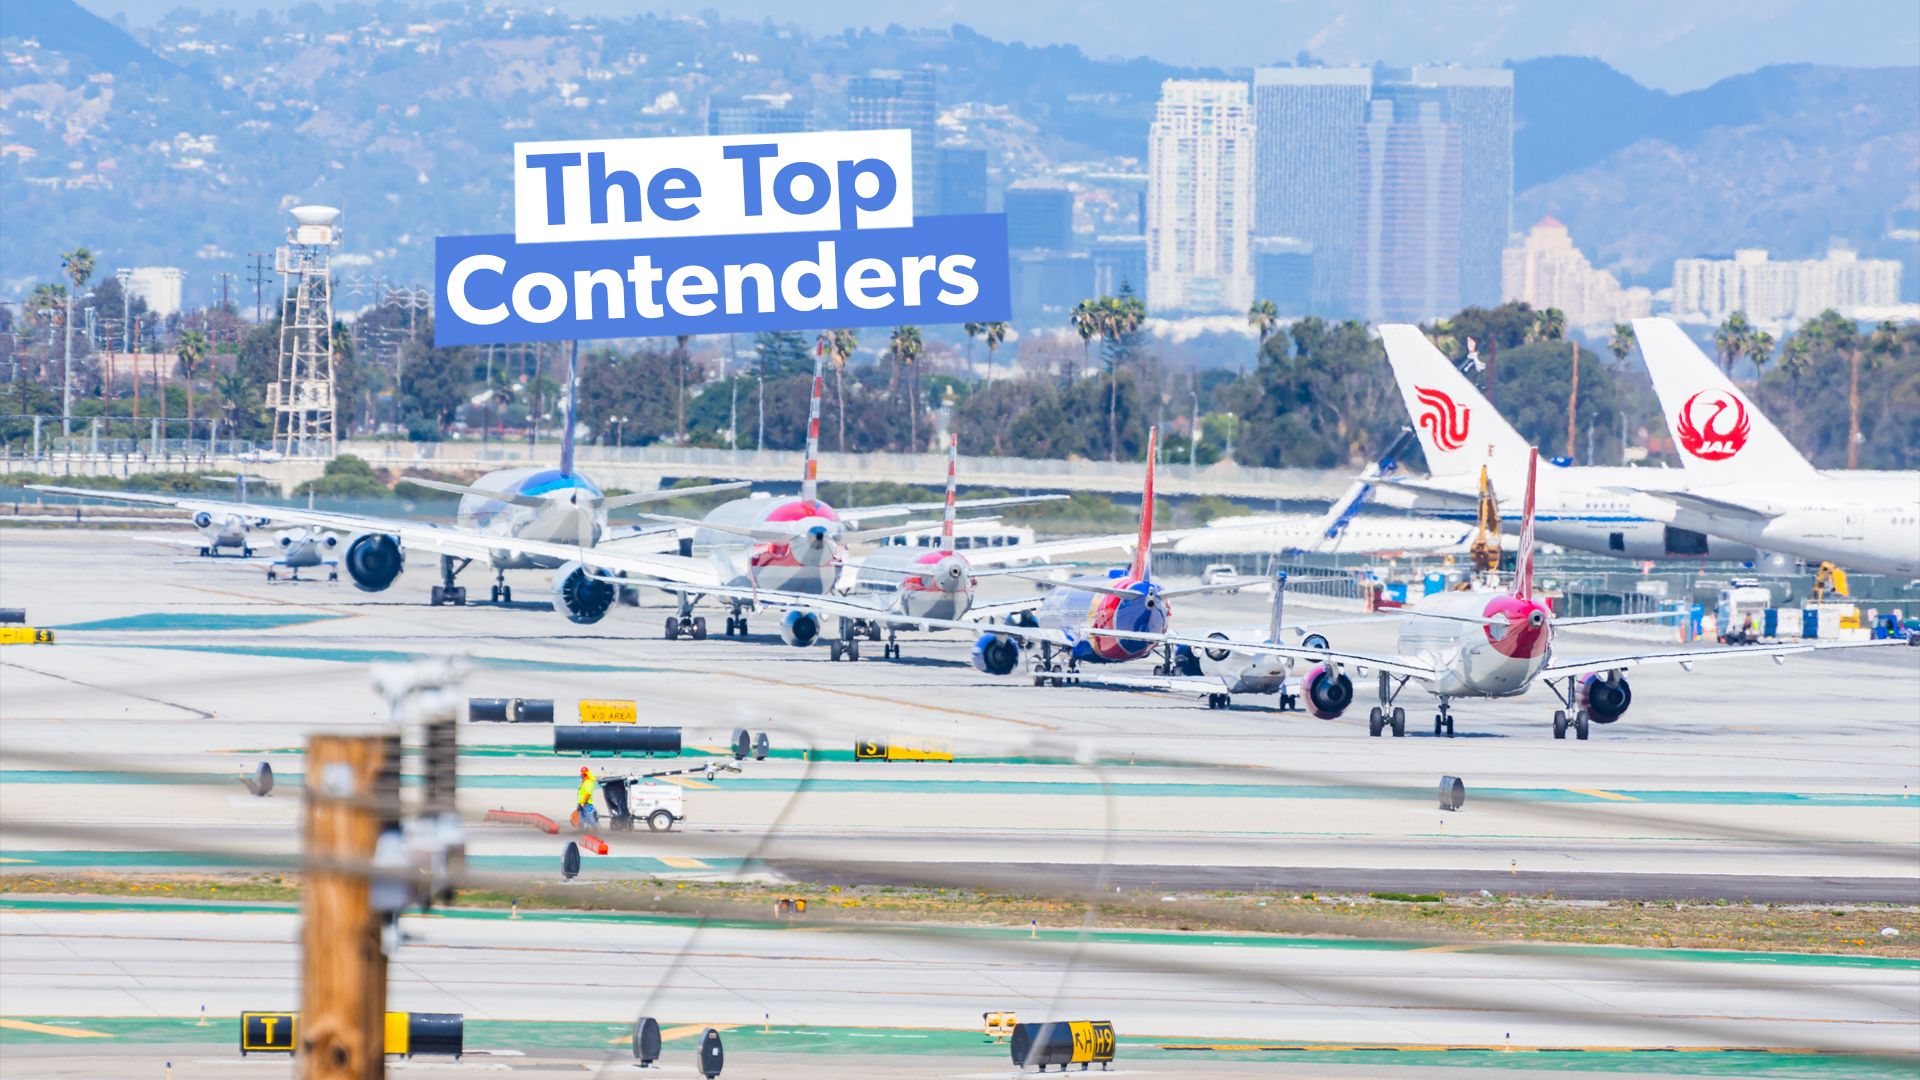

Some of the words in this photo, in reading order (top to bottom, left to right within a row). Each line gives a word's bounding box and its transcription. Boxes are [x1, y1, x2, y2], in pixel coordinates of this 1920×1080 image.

[1696, 440, 1737, 453] JAL
[608, 712, 632, 720] AREA
[866, 741, 877, 755] S
[260, 1017, 279, 1045] T
[1094, 1028, 1113, 1054] H9
